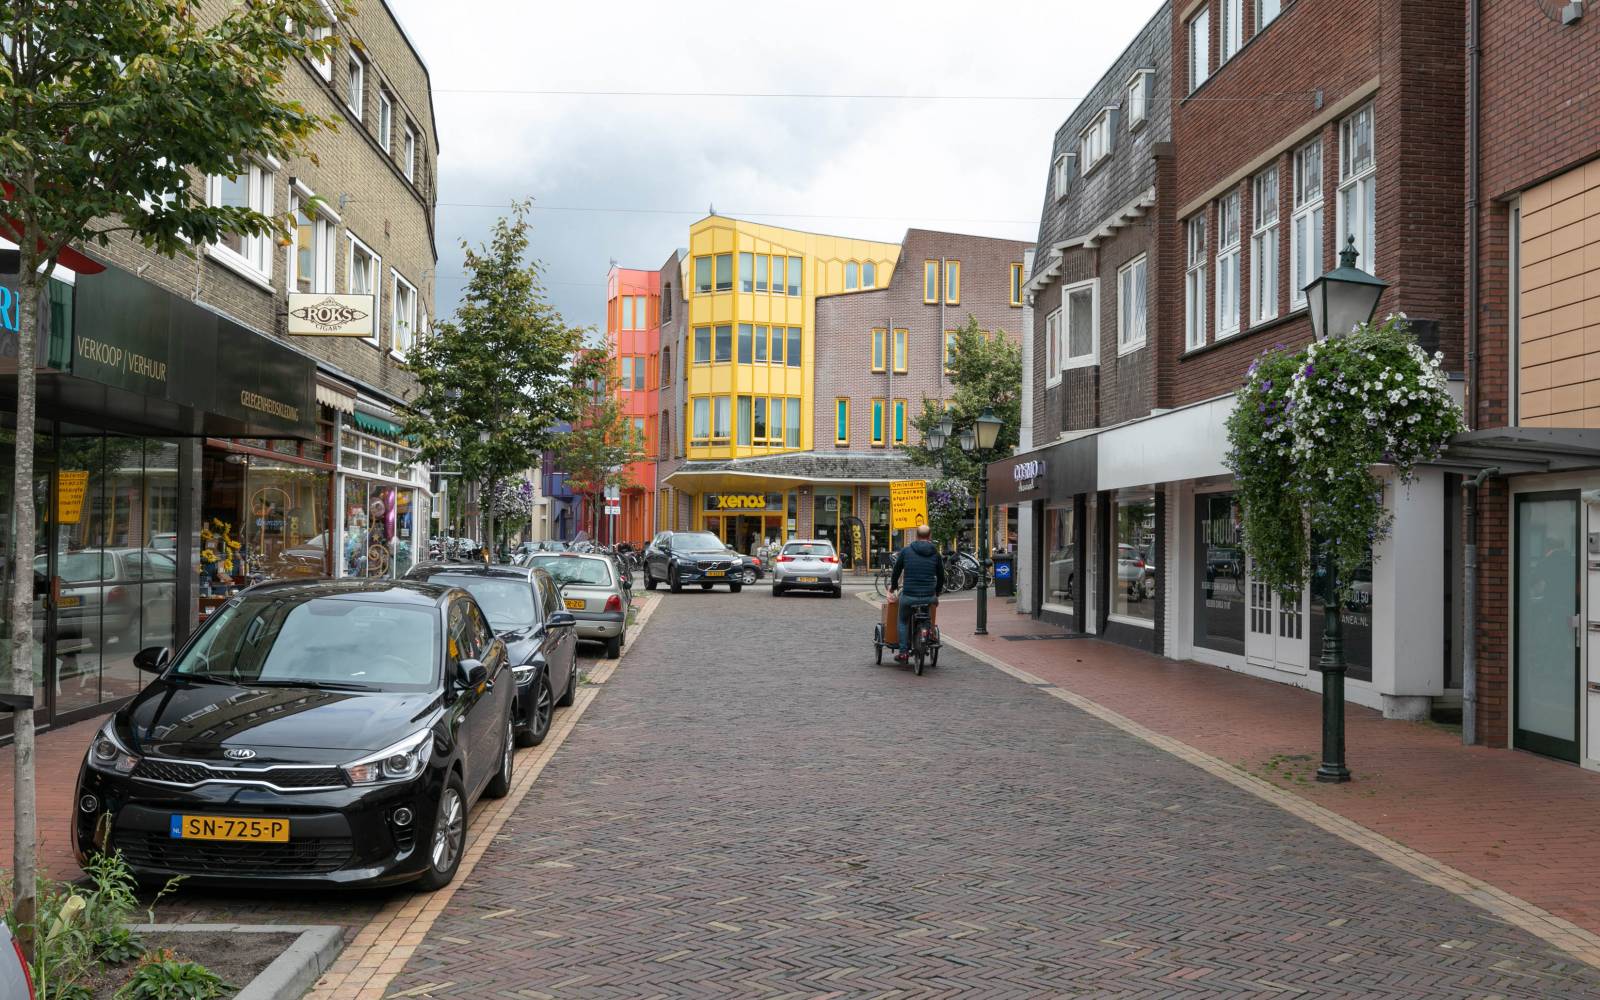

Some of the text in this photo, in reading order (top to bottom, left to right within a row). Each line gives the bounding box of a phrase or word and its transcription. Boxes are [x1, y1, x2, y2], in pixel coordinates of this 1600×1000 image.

[307, 307, 353, 321] ROKS
[78, 336, 122, 367] VERKOOP
[129, 352, 167, 381] VERHUUR
[717, 495, 766, 508] xenos
[1202, 519, 1211, 544] TE
[852, 525, 864, 560] xenos
[1341, 614, 1369, 627] ANEA.NL
[189, 819, 283, 838] SN-725-P
